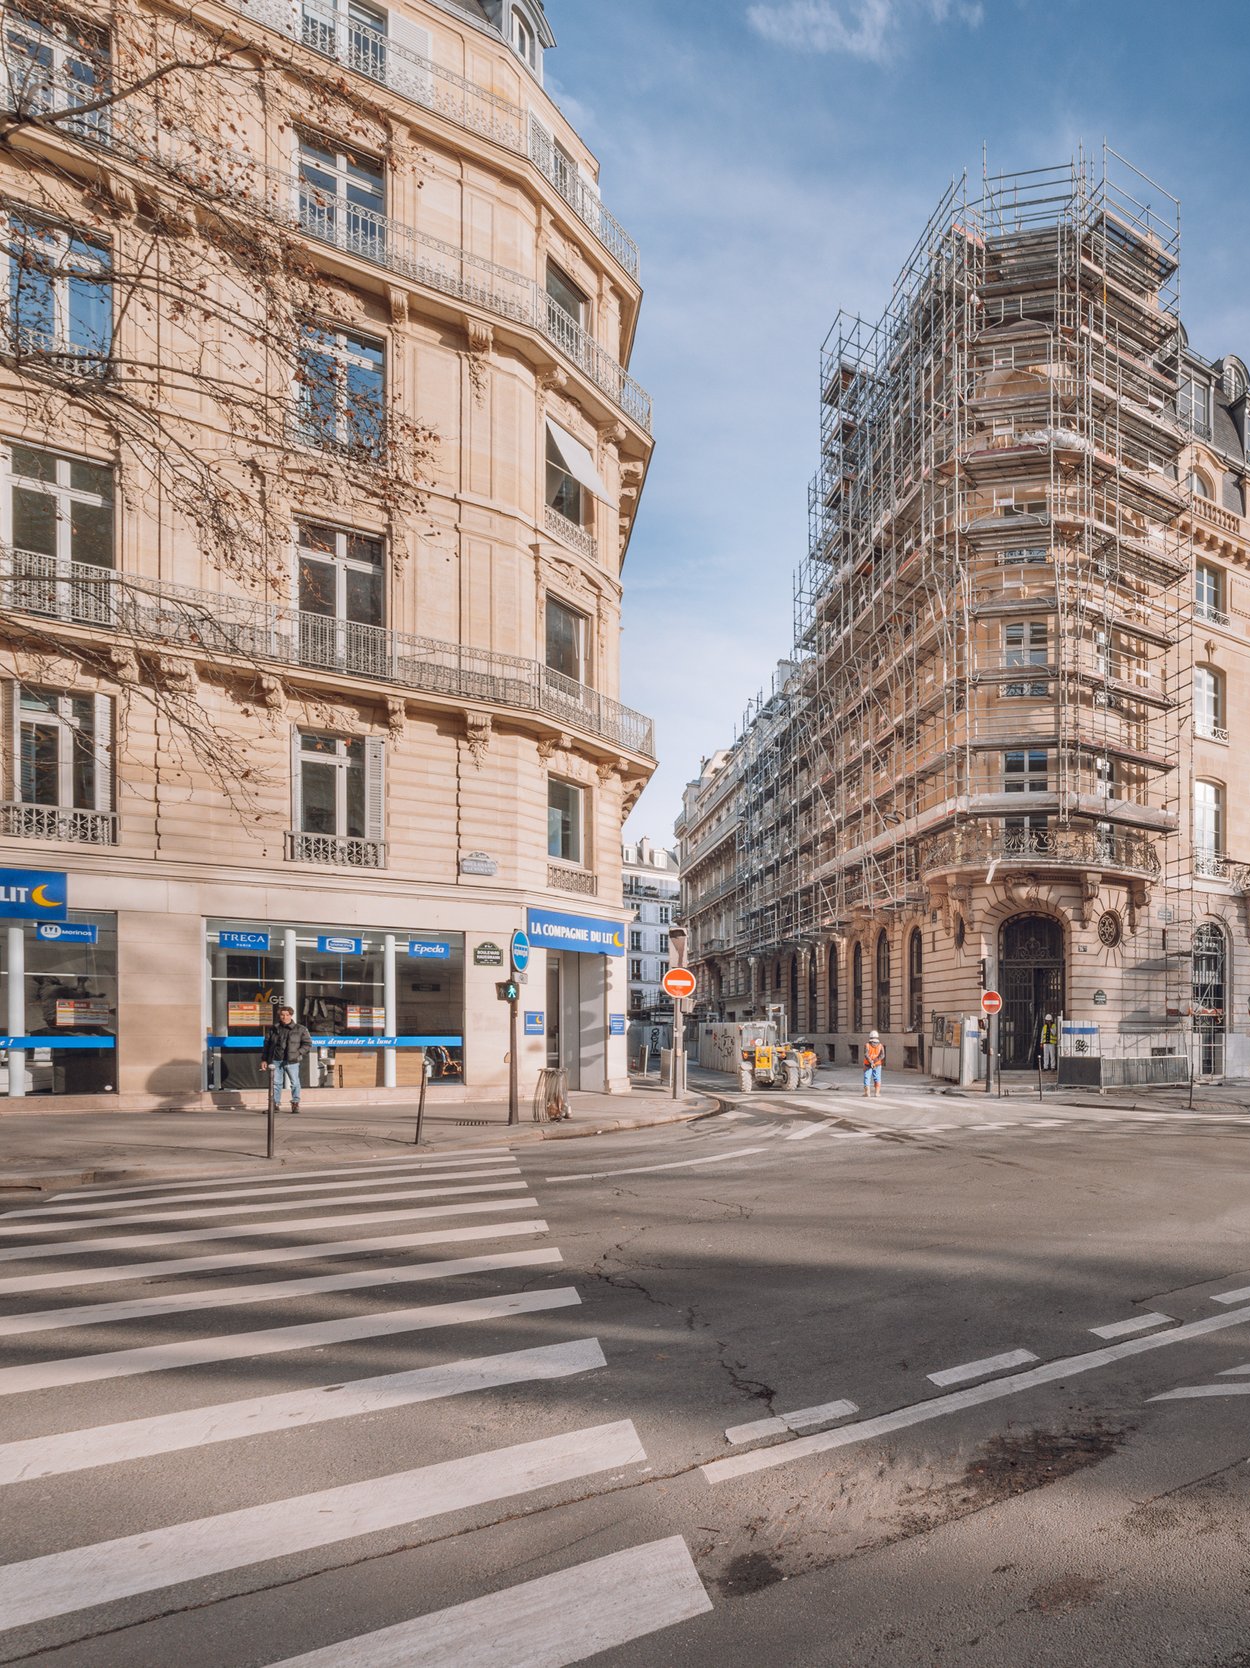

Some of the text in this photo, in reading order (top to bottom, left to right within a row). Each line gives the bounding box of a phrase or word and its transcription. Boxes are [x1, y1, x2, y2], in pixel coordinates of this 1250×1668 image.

[0, 886, 29, 903] LIT
[221, 933, 266, 943] TRECA
[531, 922, 614, 945] LA COMPAGNIE DU LIT
[413, 943, 445, 954] Epeda
